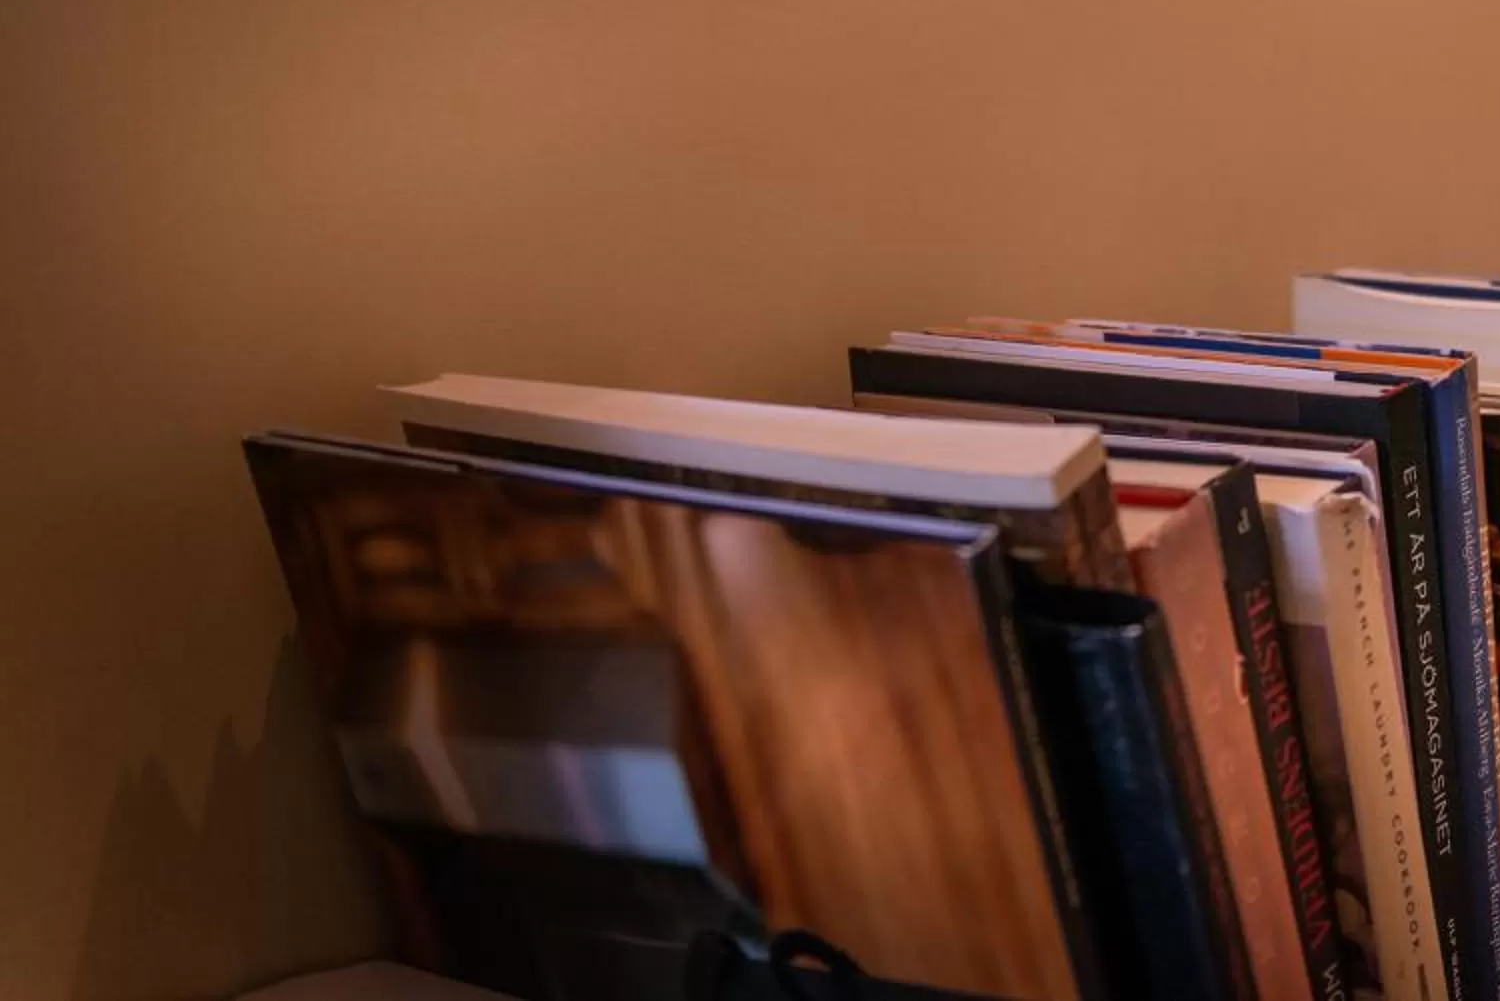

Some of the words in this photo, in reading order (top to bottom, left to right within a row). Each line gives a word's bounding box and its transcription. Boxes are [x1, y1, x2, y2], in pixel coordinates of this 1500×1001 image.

[1403, 466, 1421, 519] ETT
[1410, 532, 1427, 575] ÅR
[1414, 581, 1433, 625] PÅ
[1352, 566, 1375, 667] FRENCH
[1370, 682, 1396, 796] LAUNDRY
[1392, 814, 1421, 952] COOKBOOK
[1418, 630, 1452, 855] SJÖMAGASINET
